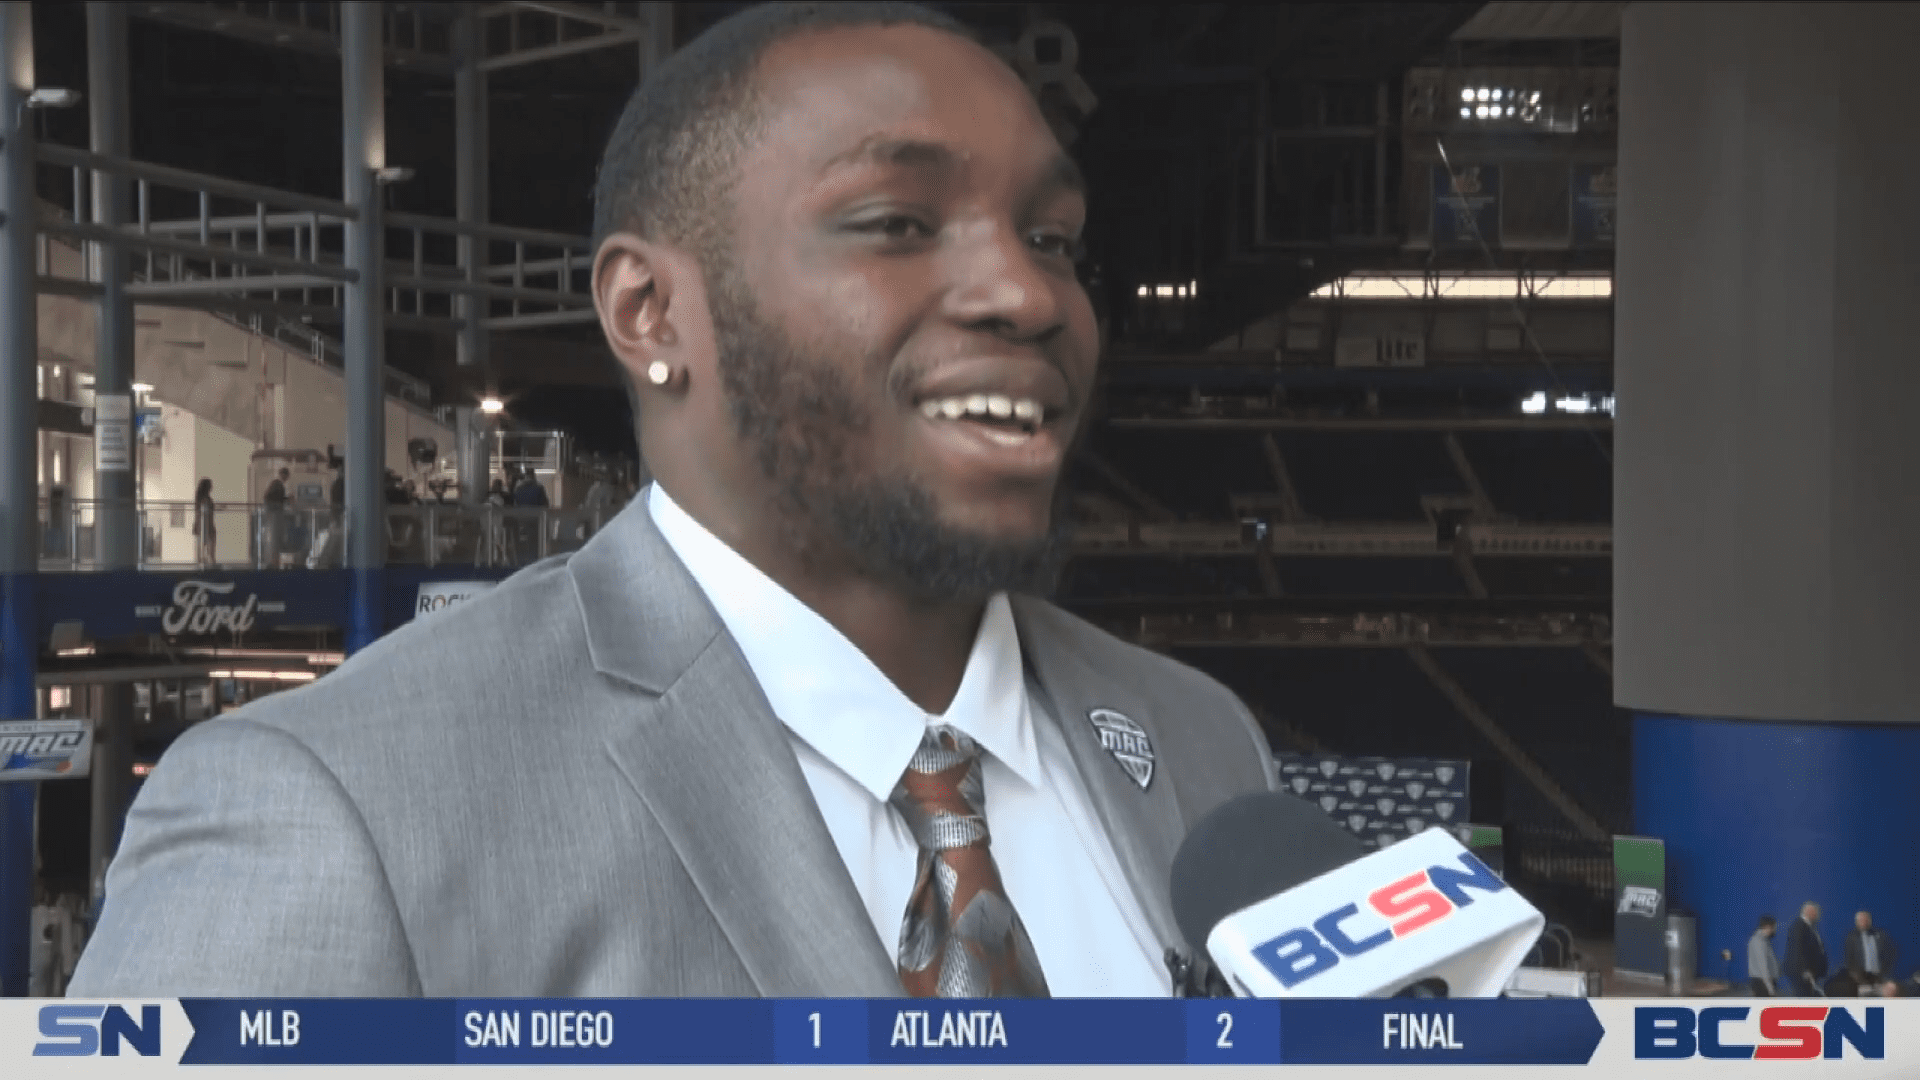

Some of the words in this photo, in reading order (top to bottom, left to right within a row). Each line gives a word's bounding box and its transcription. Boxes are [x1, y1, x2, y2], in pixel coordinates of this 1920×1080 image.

[162, 580, 257, 635] Ford
[419, 594, 471, 613] ROC
[1100, 728, 1154, 758] MAC
[1250, 850, 1506, 989] BCSN
